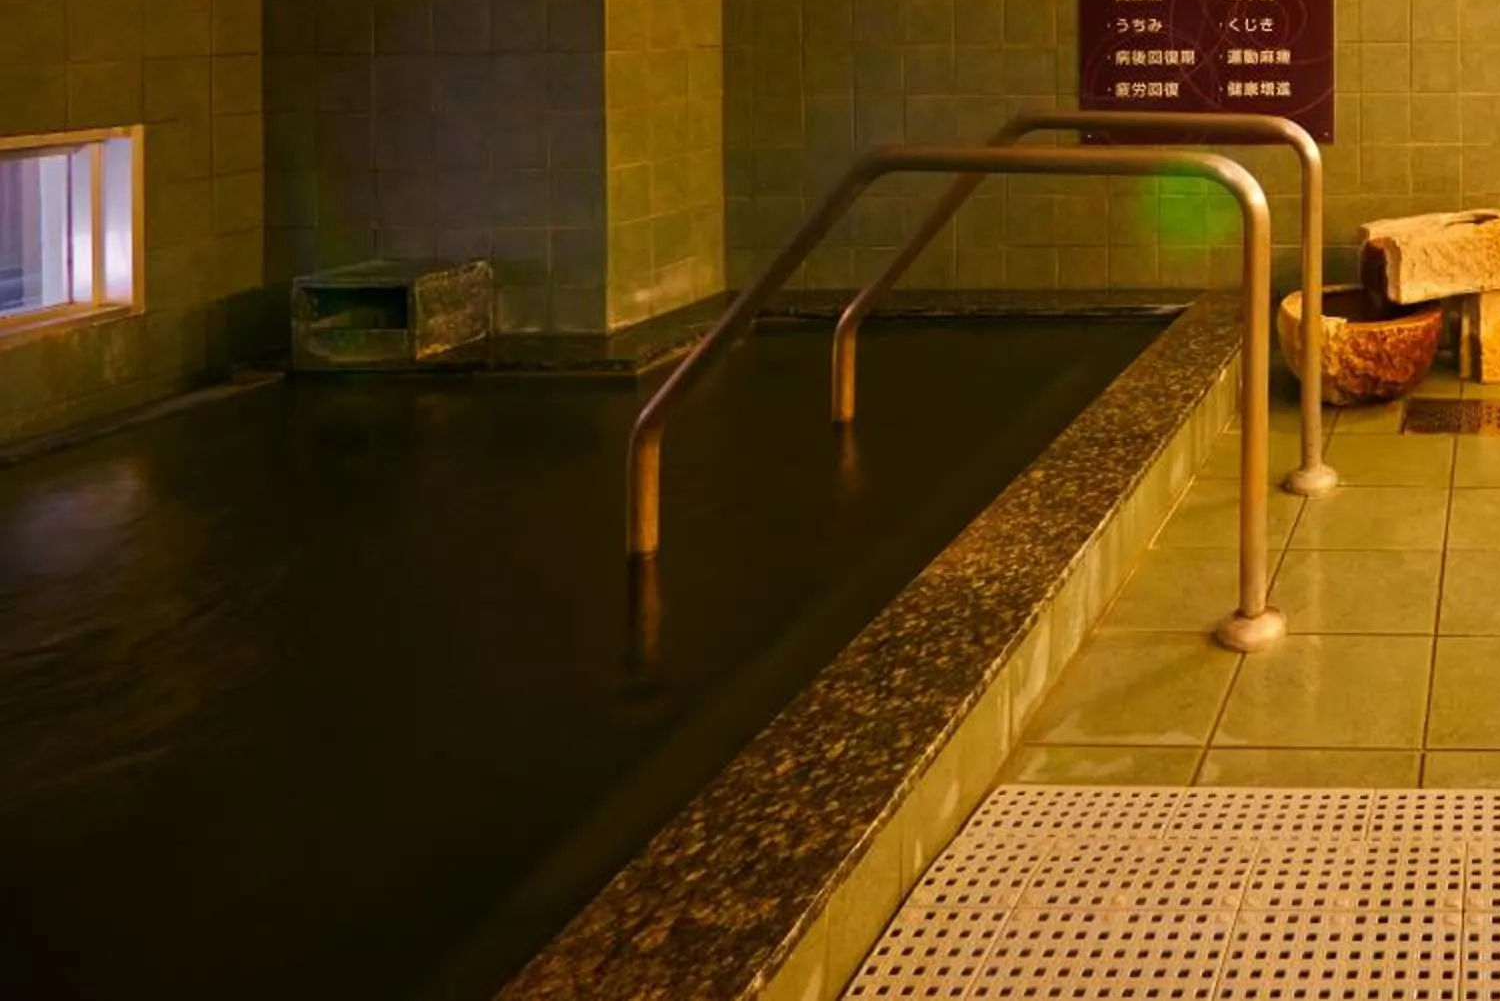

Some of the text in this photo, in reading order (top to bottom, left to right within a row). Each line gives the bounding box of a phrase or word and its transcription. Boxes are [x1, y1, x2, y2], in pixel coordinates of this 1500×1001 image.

[1116, 19, 1163, 32] うちみ
[1228, 18, 1273, 31] くじき
[1115, 50, 1196, 65] 病後回復期
[1115, 82, 1180, 97] 疲労回復
[1227, 81, 1292, 97] 健康増進
